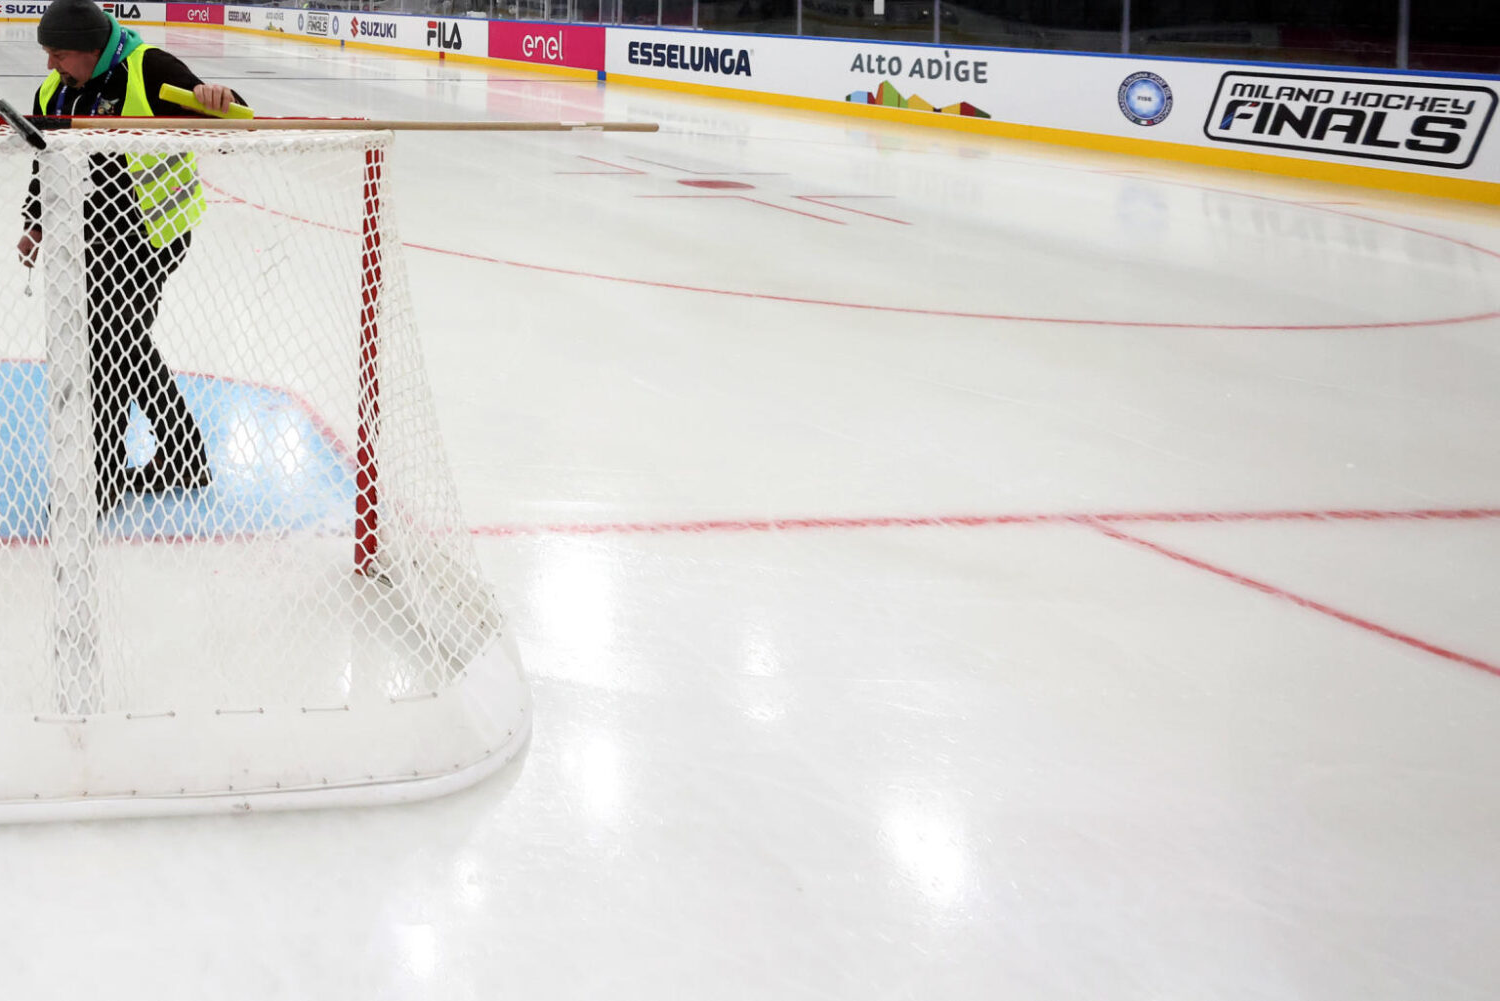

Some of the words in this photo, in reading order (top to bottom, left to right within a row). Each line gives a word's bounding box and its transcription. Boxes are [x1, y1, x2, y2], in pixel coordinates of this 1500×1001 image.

[5, 4, 47, 14] SUZU
[103, 3, 141, 19] FILA
[187, 7, 209, 22] enel
[308, 21, 327, 32] FINALS
[360, 21, 396, 38] SUZUKI
[427, 21, 462, 50] FILA
[522, 30, 563, 60] enel
[628, 41, 752, 77] ESSELUNGA
[1230, 83, 1334, 104] MILANO
[1341, 91, 1476, 115] HOCKEY
[1219, 99, 1467, 154] FINALS
